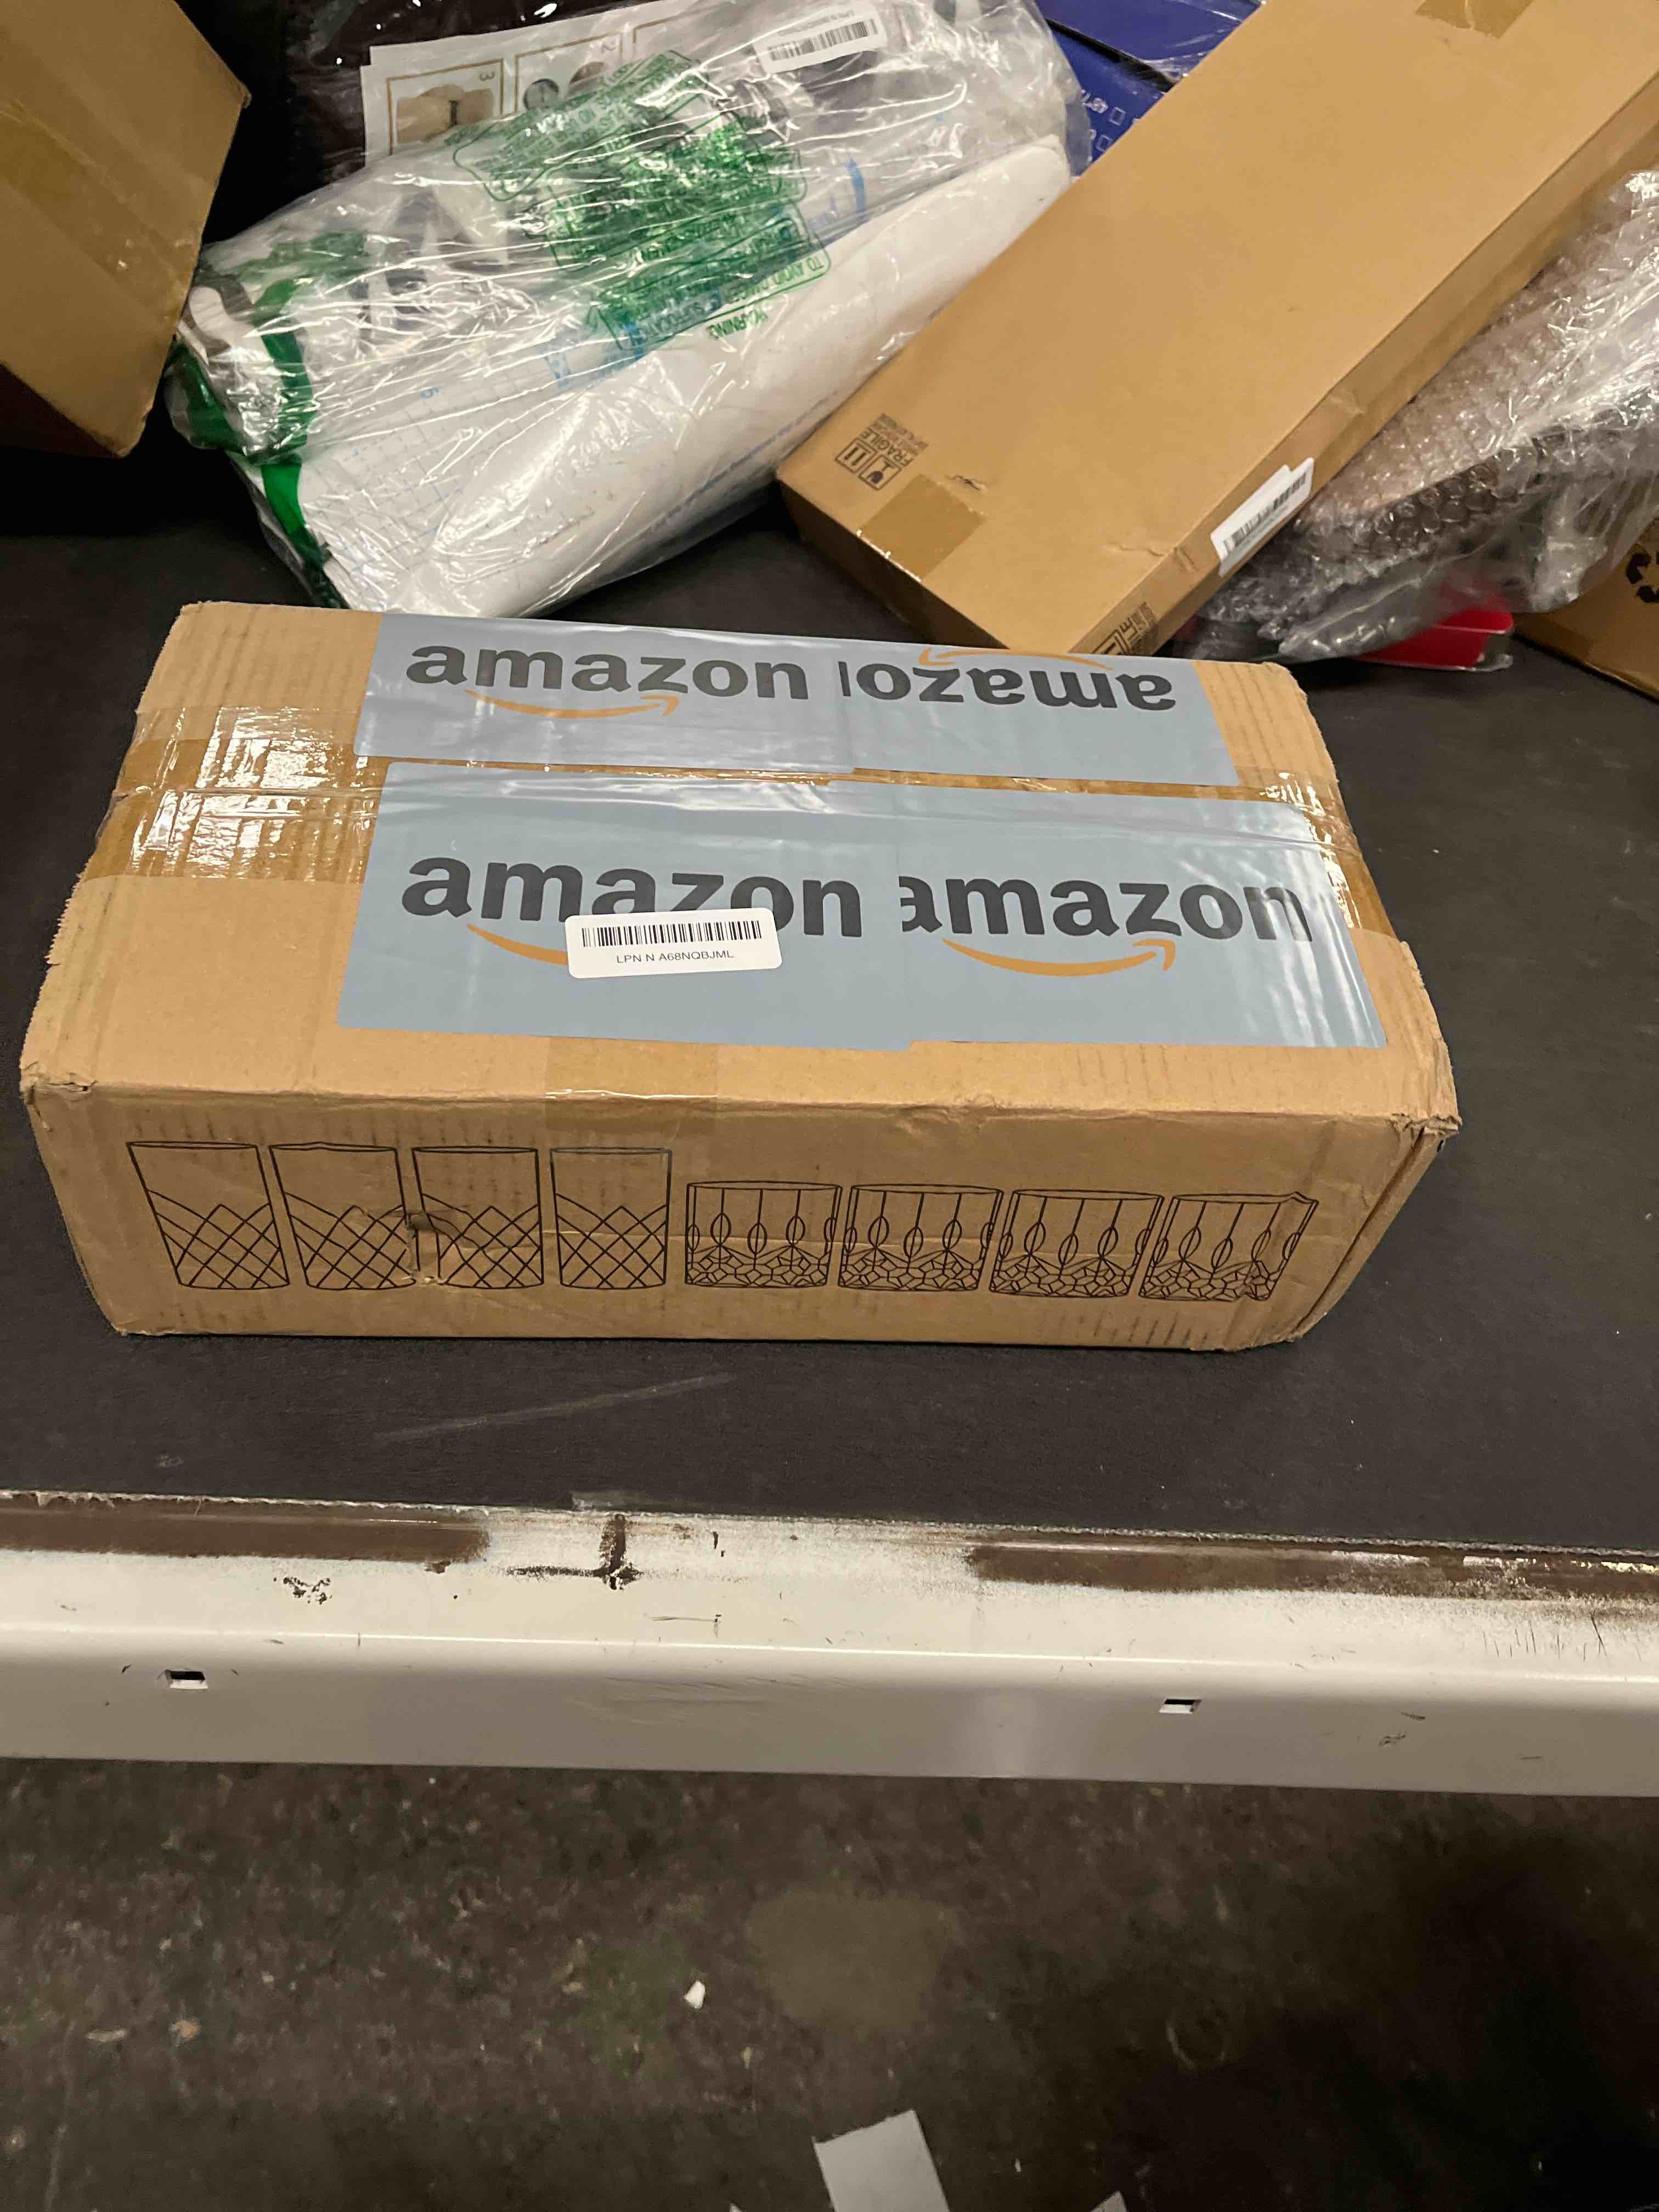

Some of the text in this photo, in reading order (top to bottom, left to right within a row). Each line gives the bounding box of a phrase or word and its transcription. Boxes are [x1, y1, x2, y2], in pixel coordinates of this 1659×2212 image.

[860, 426, 915, 467] FRAGILE
[405, 646, 809, 700] amazon
[839, 661, 1176, 711] amazo
[401, 857, 862, 938] amazon
[617, 955, 641, 963] LPN
